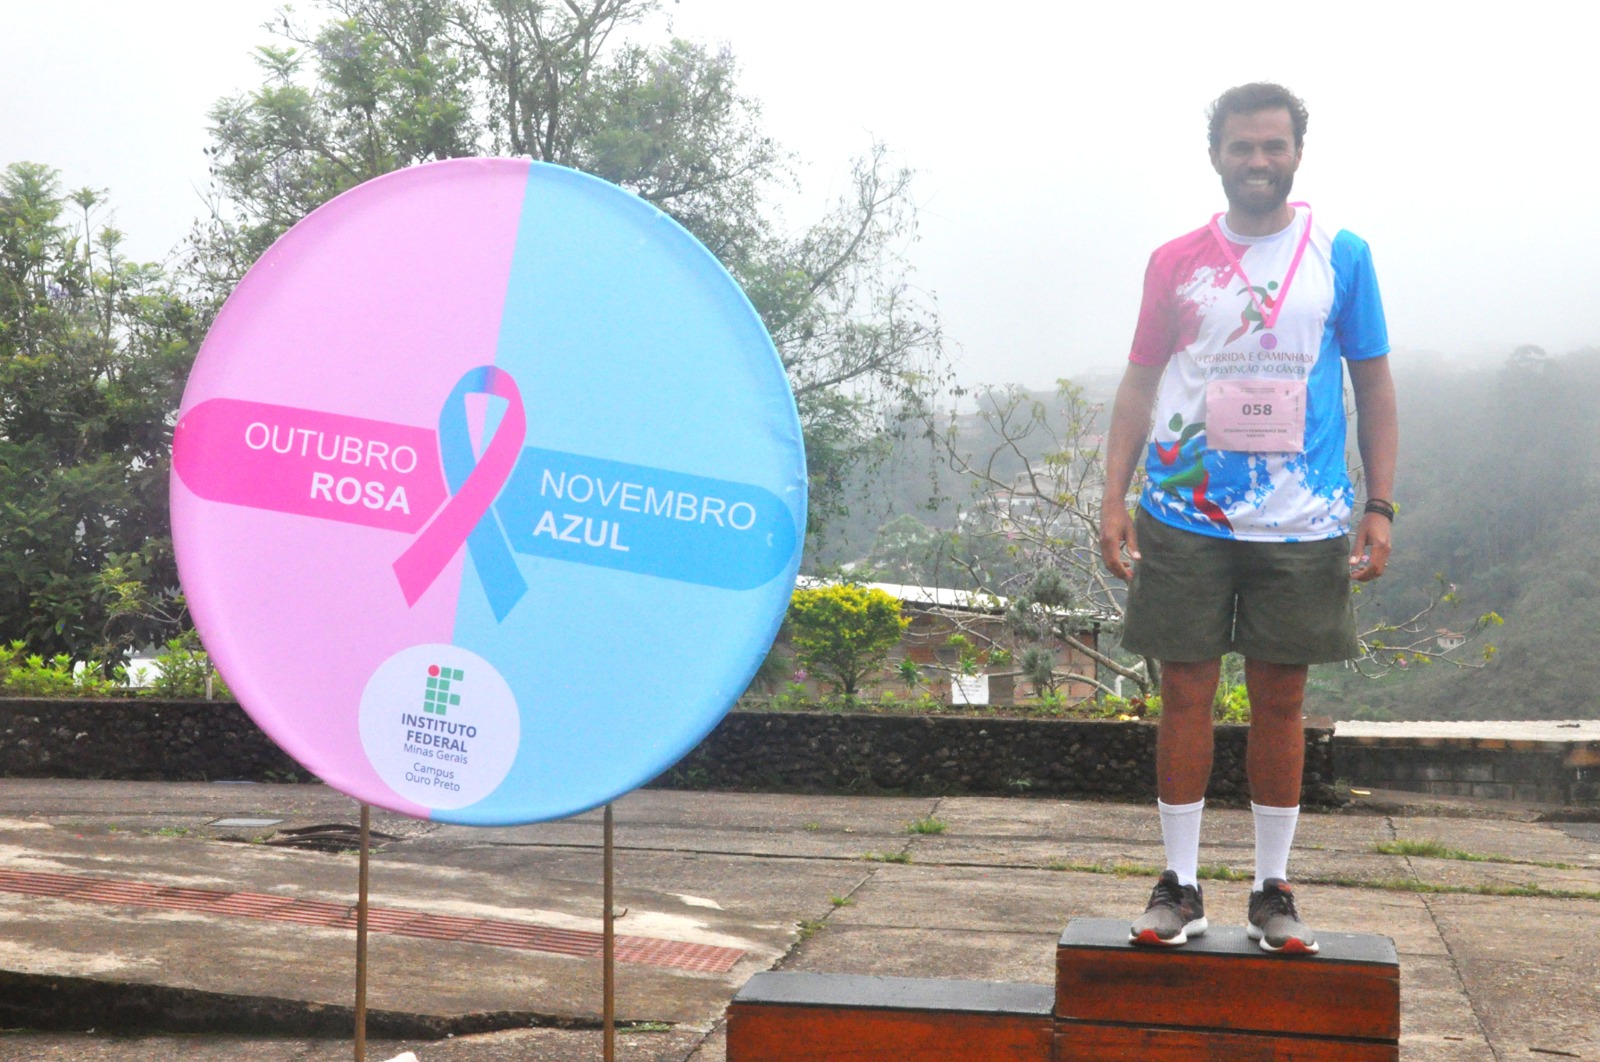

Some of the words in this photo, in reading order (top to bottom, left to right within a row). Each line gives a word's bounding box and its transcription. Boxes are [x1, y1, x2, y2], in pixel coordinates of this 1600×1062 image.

[1203, 352, 1246, 364] CORRIDA
[1248, 352, 1255, 361] E
[1257, 351, 1314, 364] CAMINHADA
[1210, 363, 1259, 374] PREVENÇÃO
[1261, 364, 1274, 373] AO
[1275, 362, 1306, 374] CÂNCER
[1242, 404, 1273, 415] 058
[245, 421, 418, 474] OUTUBRO
[310, 471, 411, 514] ROSA
[540, 468, 757, 531] NOVEMBRO
[532, 510, 630, 552] AZUL
[401, 713, 477, 738] INSTITUTO
[406, 730, 468, 753] FEDERAL
[403, 743, 434, 758] Minas
[436, 750, 468, 764] Gerais
[405, 771, 431, 786] Ouro
[433, 776, 461, 792] Preto
[413, 762, 455, 780] Campus
